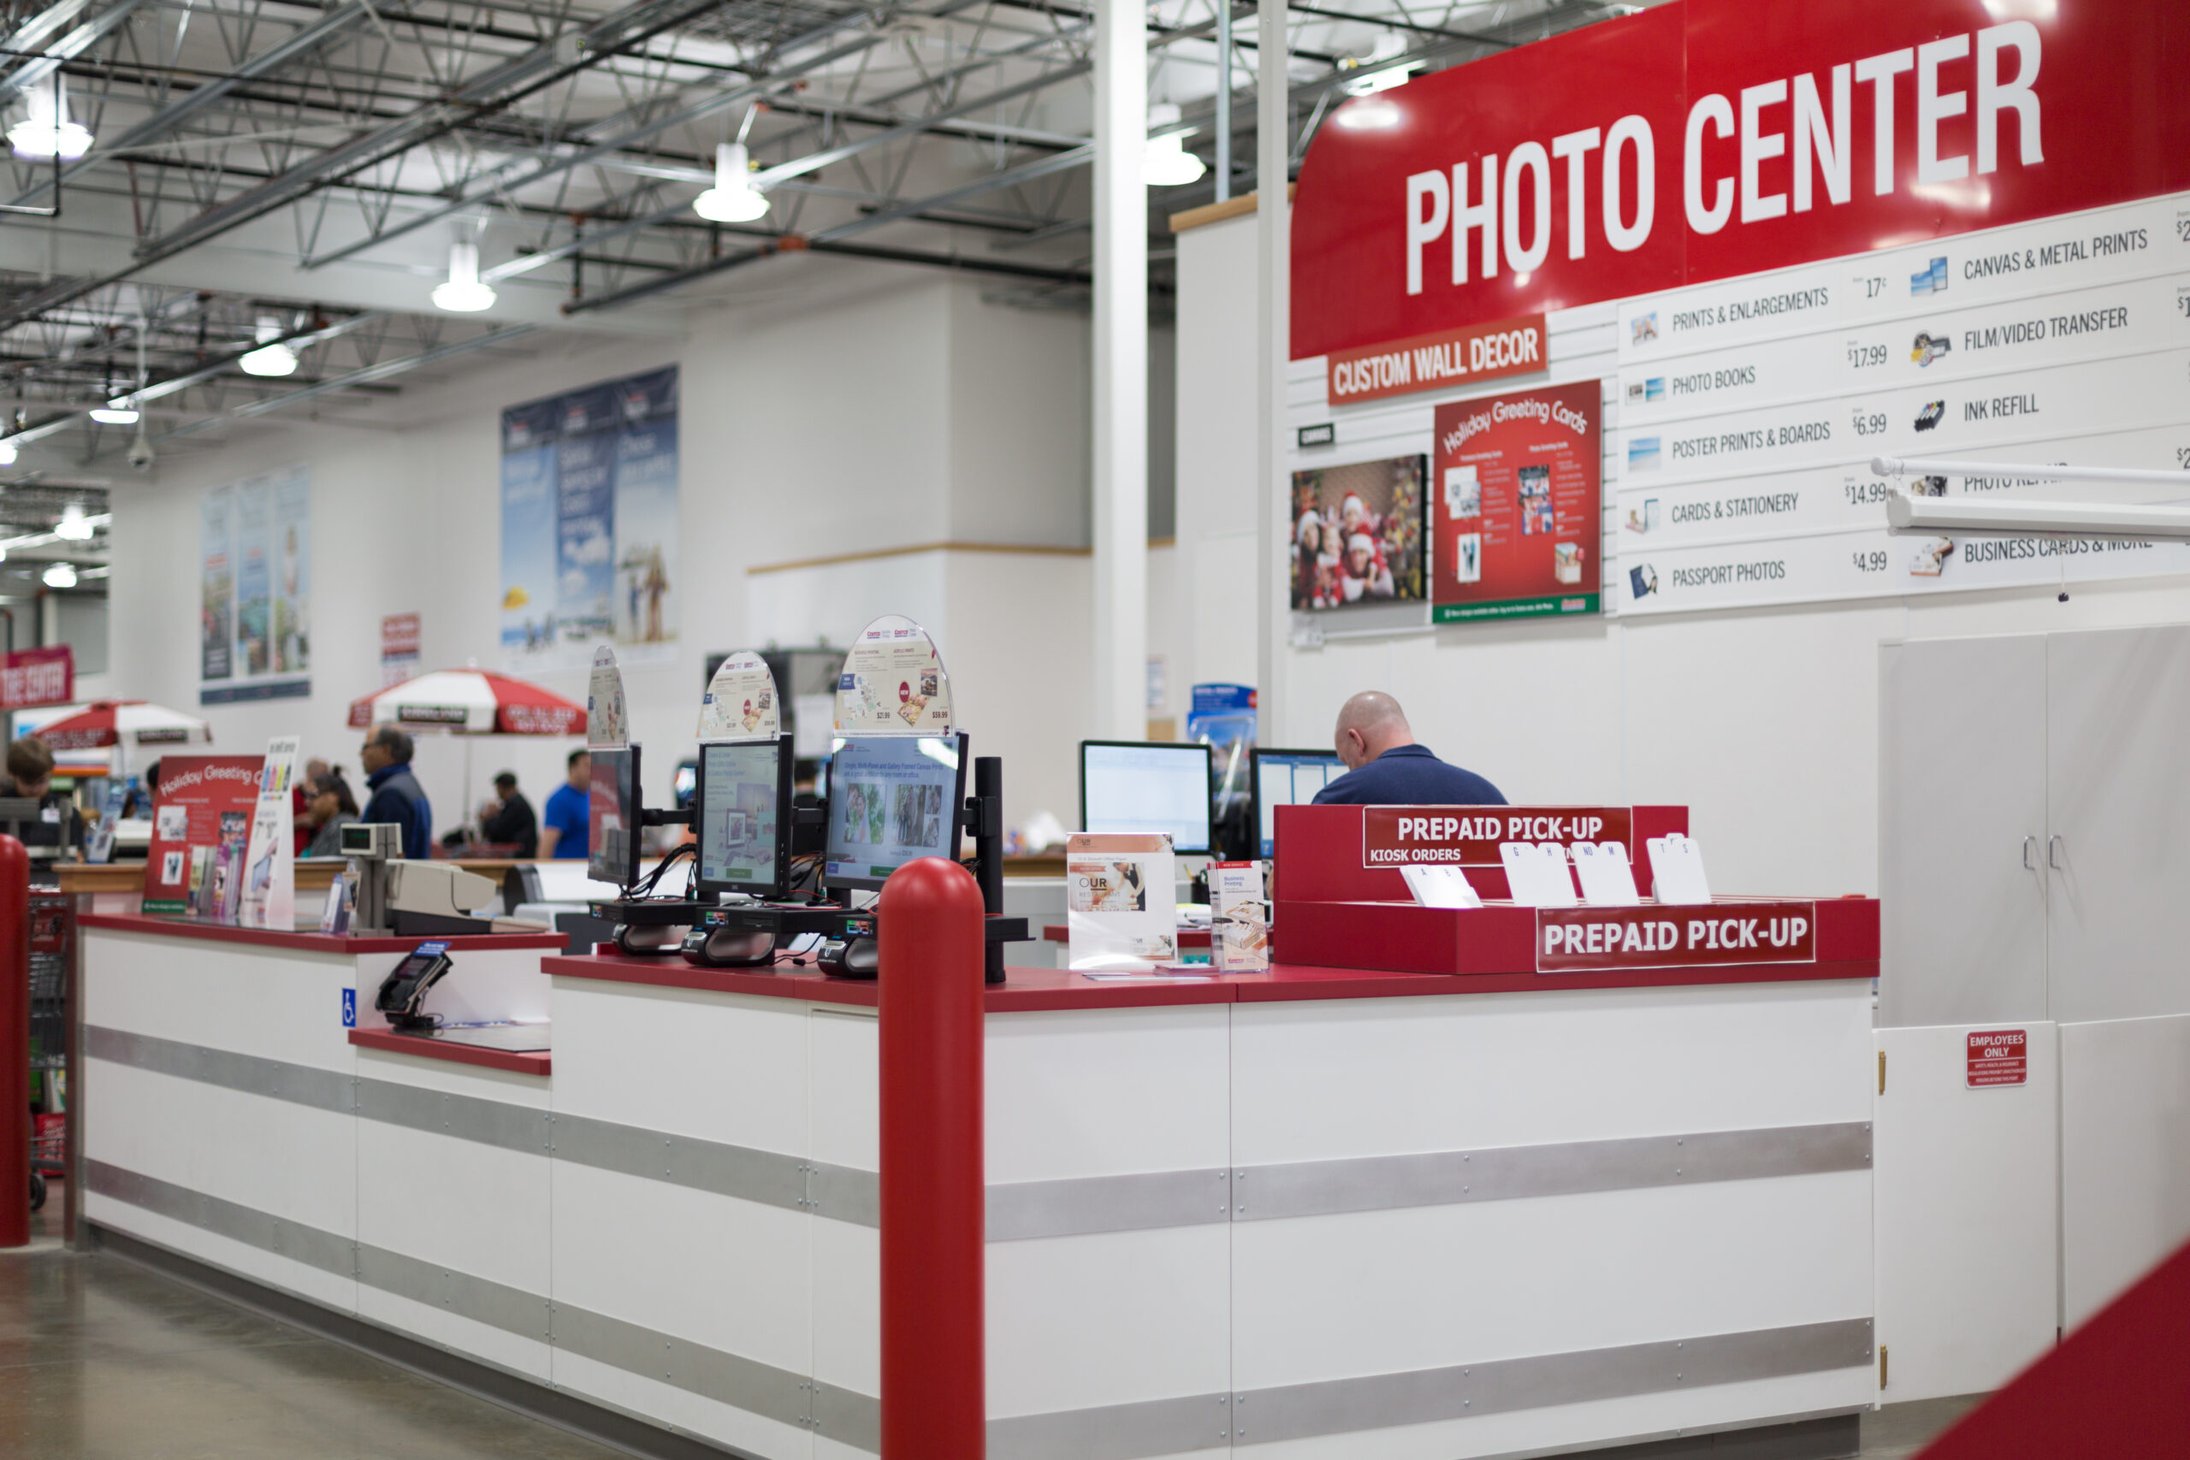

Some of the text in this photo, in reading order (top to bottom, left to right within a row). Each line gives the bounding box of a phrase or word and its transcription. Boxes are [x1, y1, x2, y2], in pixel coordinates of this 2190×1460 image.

[1406, 19, 2044, 296] PHOTO CENTER
[1964, 228, 2148, 280] CANVAS & METAL PRINTS
[1673, 287, 1829, 331] PRINTS & ENLARGEMENTS
[1965, 306, 2128, 351] FILM/VIDEO TRANSFER
[1333, 327, 1539, 397] CUSTOM WALL DECOR
[1847, 345, 1887, 368] $17.99
[1673, 366, 1756, 395] PHOTO BOOKS
[1964, 393, 2039, 422] INK REFILL
[1442, 398, 1588, 455] Holiday Greeting Cards
[1852, 414, 1887, 436] $6.99
[1673, 421, 1831, 459] POSTER PRINTS & BOARDS
[1672, 493, 1799, 523] CARDS & STATIONERY
[1845, 482, 1887, 505] $14.99
[1852, 551, 1887, 572] $4.99
[1965, 538, 2036, 563] BUSINESS
[2038, 540, 2089, 557] CARDS
[1673, 560, 1785, 587] PASSPORT PHOTOS
[160, 770, 202, 796] Holiday
[204, 764, 251, 785] Greeting
[1398, 816, 1603, 841] PREPAID PICK-UP
[1370, 848, 1461, 862] KIOSK ORDERS
[1079, 878, 1107, 888] OUR
[1544, 916, 1808, 955] PREPAID PICK-UP
[1970, 1034, 2024, 1047] EMPLOYEES
[1984, 1047, 2010, 1058] ONLY
